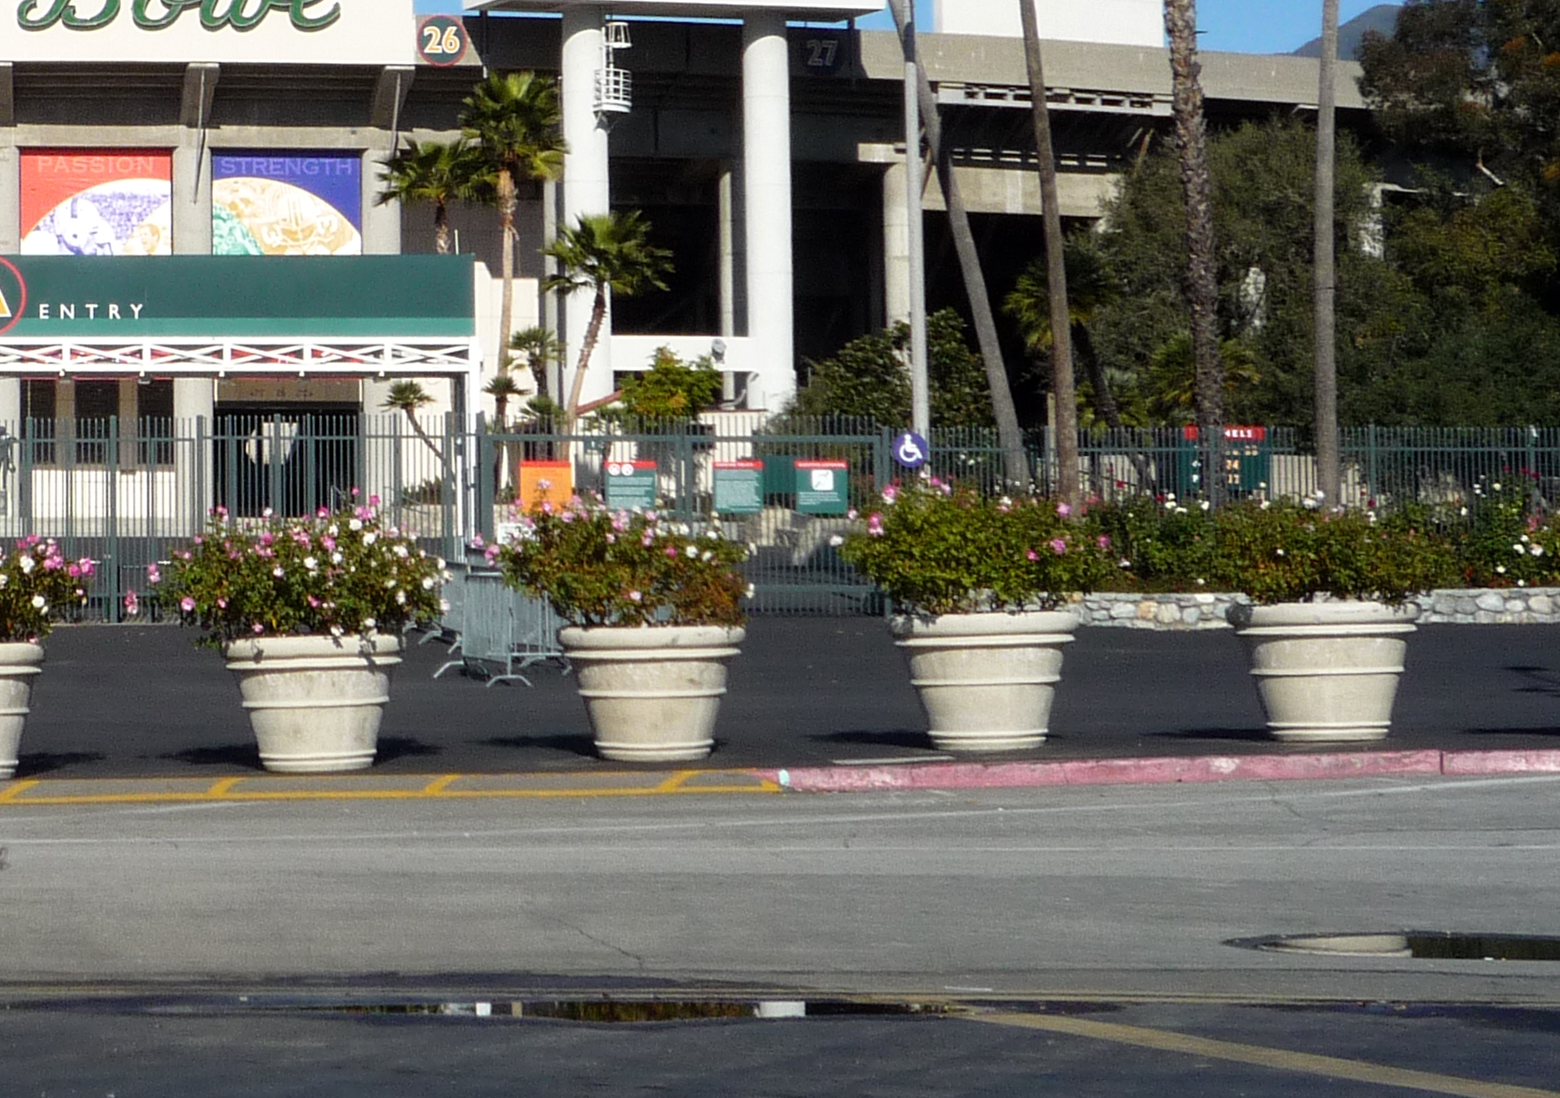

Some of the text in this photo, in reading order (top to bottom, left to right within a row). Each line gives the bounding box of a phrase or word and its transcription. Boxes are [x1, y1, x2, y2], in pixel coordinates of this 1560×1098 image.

[423, 25, 460, 54] 26
[806, 40, 838, 66] 27
[38, 157, 154, 173] PASSION
[221, 158, 353, 174] STRENGTH
[39, 304, 144, 320] ENTRY
